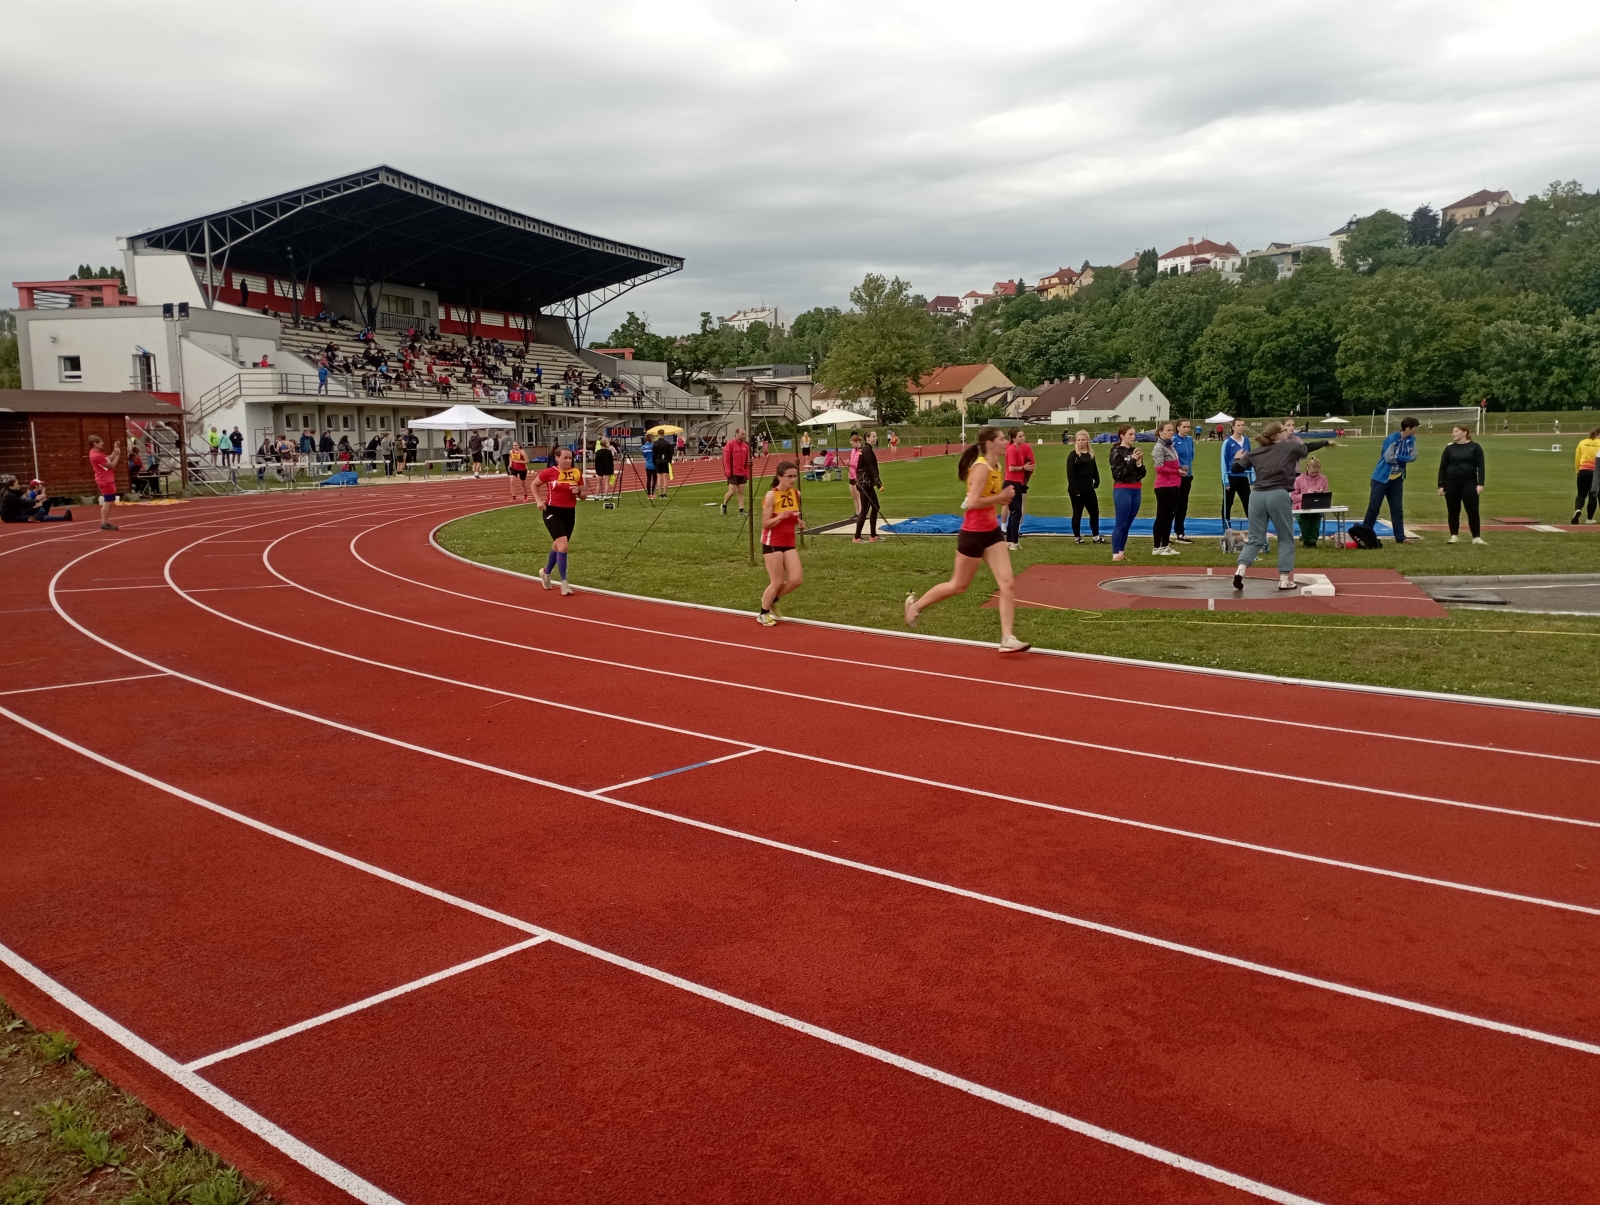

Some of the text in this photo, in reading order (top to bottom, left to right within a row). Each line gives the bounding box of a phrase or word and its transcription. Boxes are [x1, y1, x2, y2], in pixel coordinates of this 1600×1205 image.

[611, 428, 631, 437] 10:00
[562, 471, 575, 481] 25
[780, 494, 794, 508] 26
